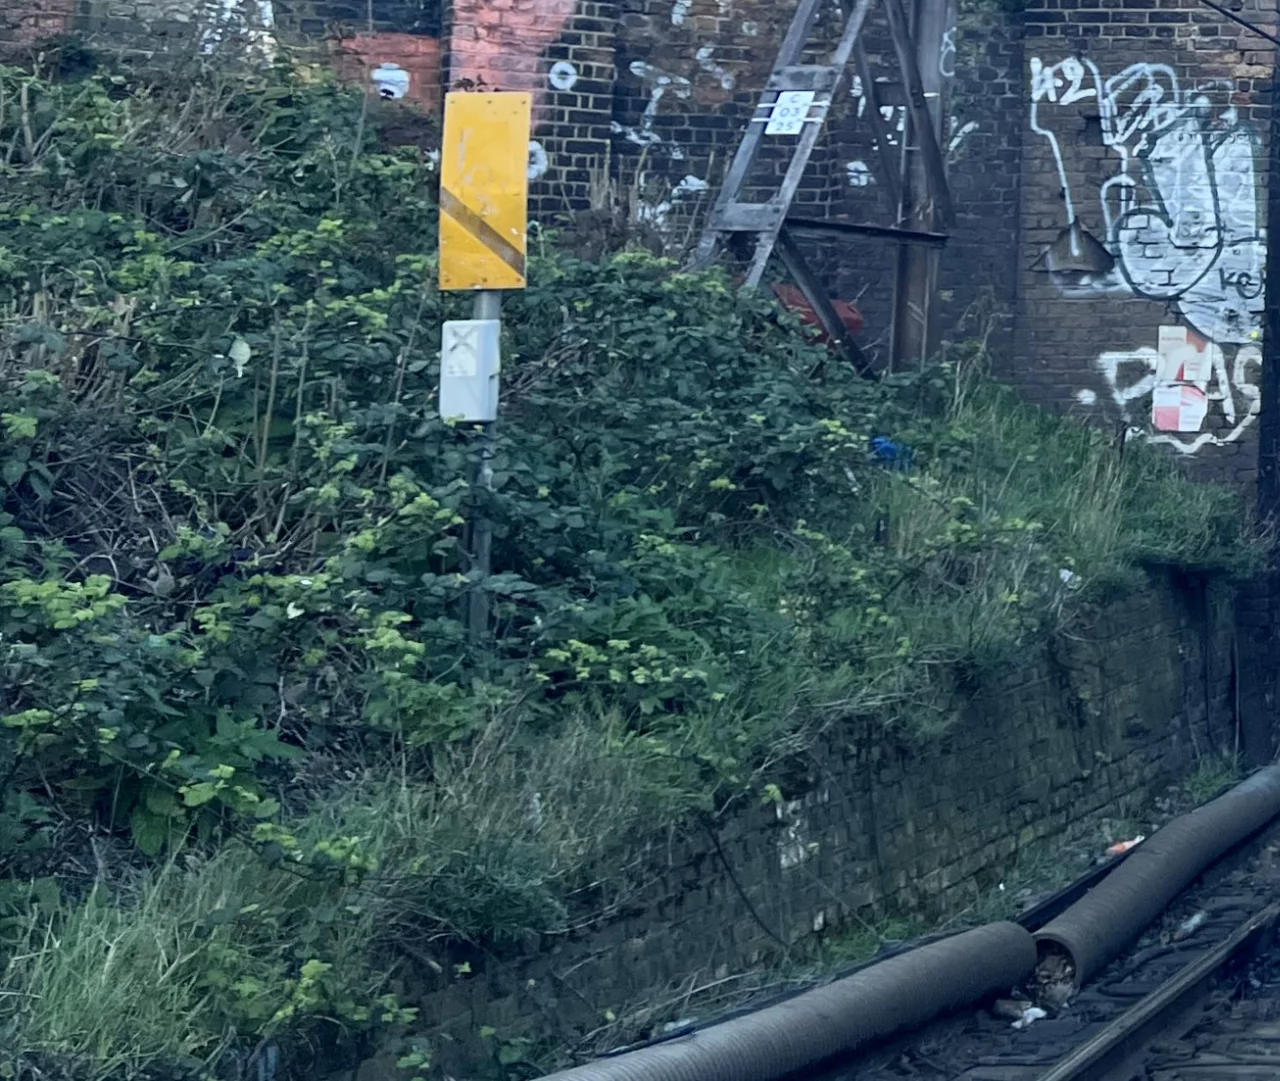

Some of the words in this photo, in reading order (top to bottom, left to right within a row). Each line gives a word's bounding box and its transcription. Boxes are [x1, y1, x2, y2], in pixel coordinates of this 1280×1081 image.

[789, 93, 801, 104] C
[779, 107, 801, 118] 03
[775, 121, 796, 132] 25
